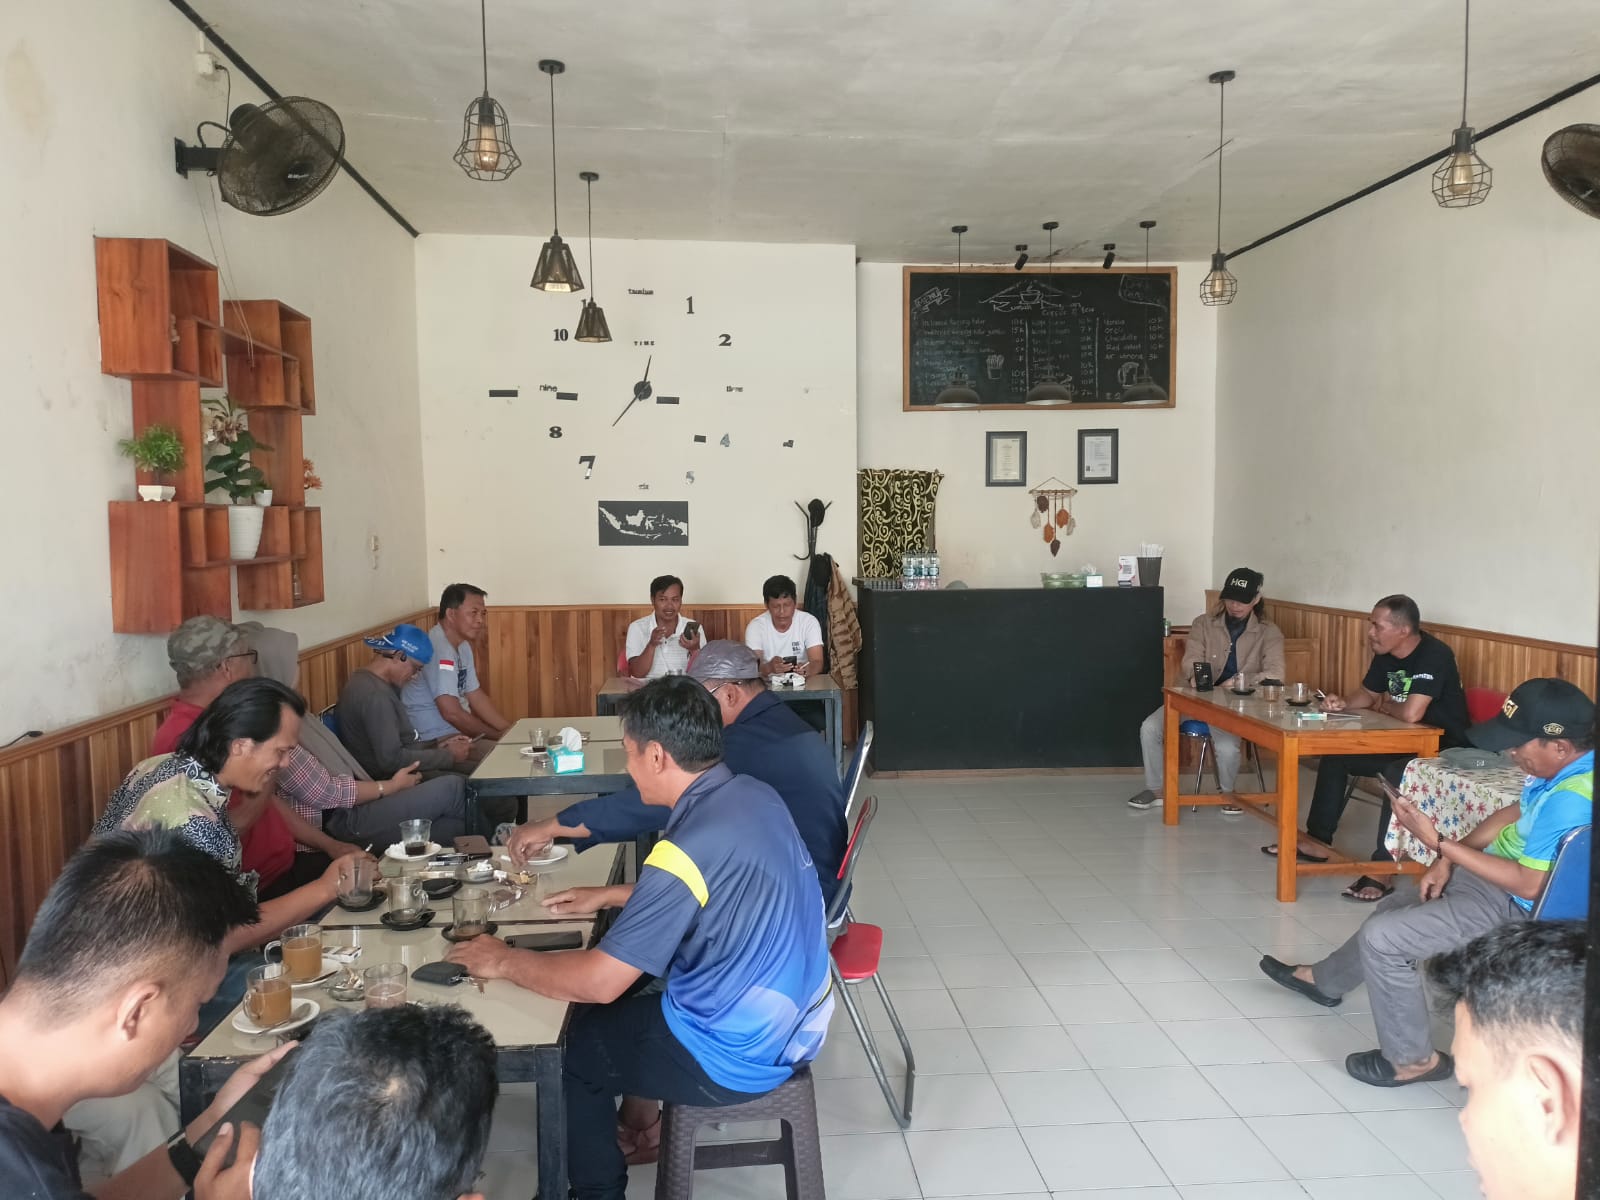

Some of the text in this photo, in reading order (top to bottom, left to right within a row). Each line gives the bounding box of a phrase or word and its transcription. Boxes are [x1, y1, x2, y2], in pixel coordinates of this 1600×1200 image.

[686, 296, 695, 314] 1
[553, 328, 569, 342] 10
[719, 333, 732, 347] 2
[539, 384, 558, 392] nine
[549, 426, 563, 438] 8
[579, 455, 596, 480] 7
[1230, 577, 1248, 588] HGI
